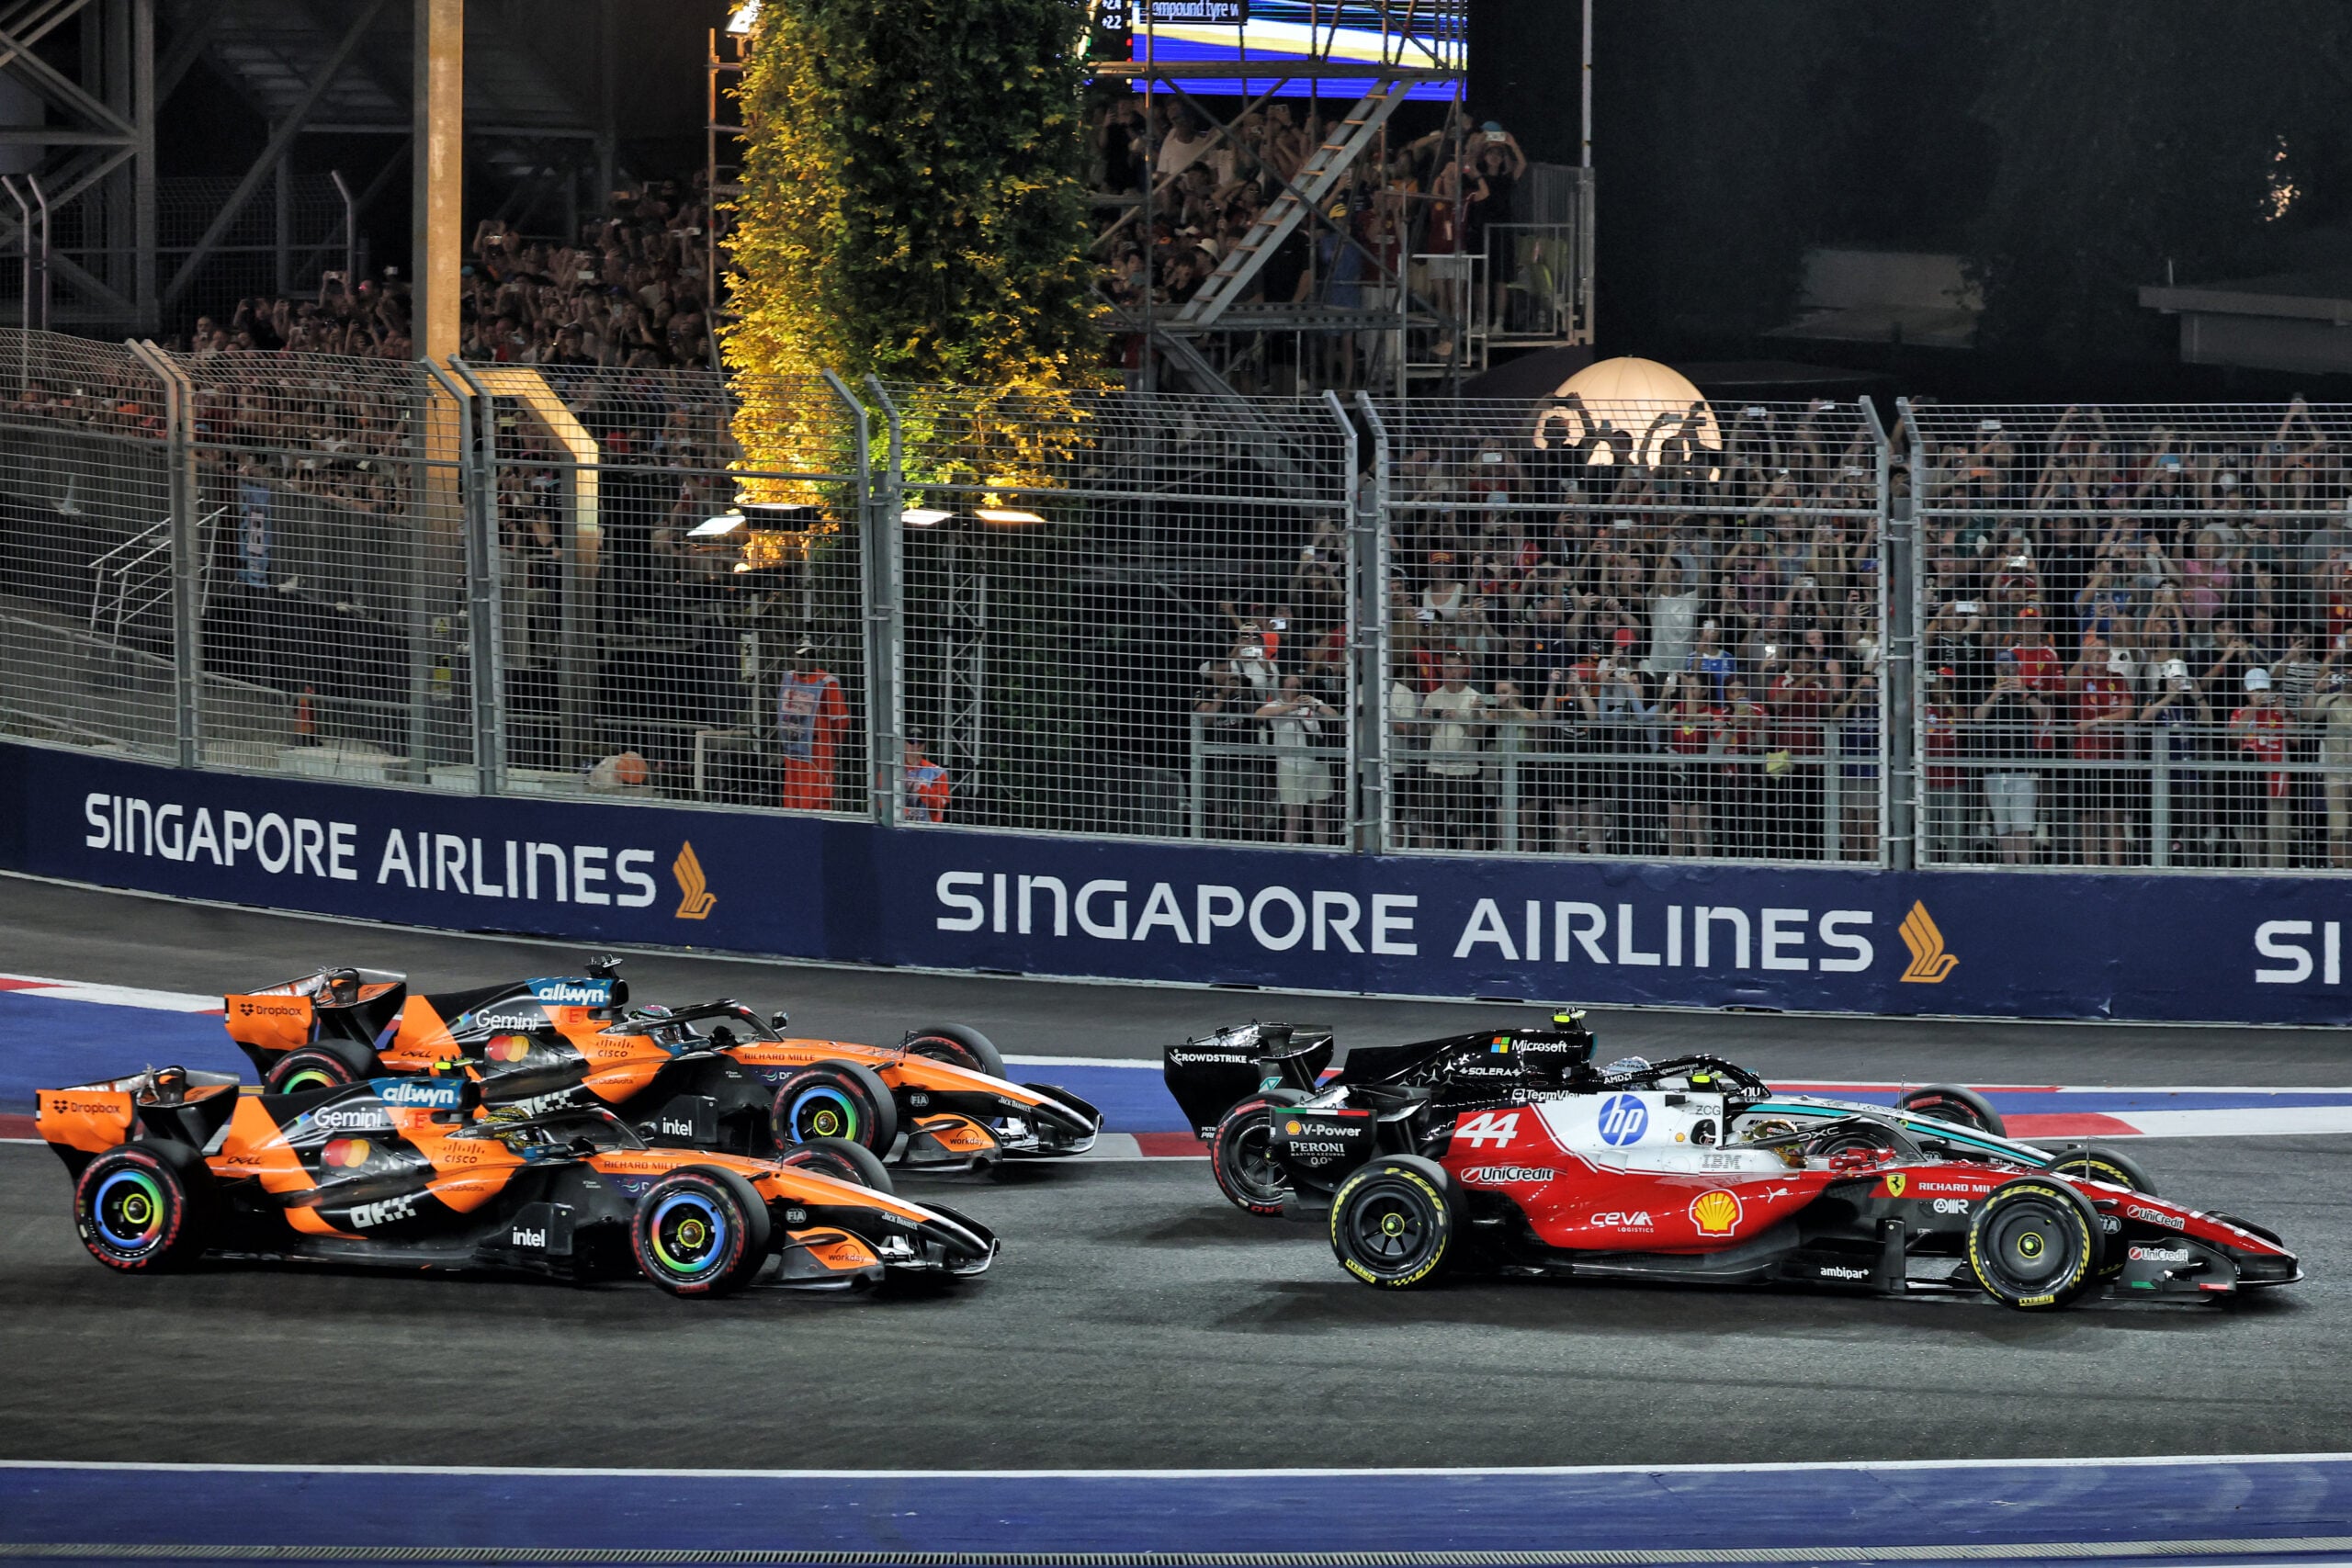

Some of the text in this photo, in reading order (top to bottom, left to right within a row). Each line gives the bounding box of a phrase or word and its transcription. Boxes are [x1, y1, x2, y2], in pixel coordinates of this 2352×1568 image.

[85, 792, 656, 908] SINGAPORE AIRLINES
[936, 871, 1874, 973] SINGAPORE AIRLINES
[538, 983, 605, 1006] allwyn
[255, 1005, 302, 1017] Dropbox
[476, 1010, 539, 1031] Gemini
[1511, 1039, 1567, 1053] Microsoft
[744, 1053, 816, 1062] RICHARD MILLE
[1175, 1053, 1248, 1064] CROWDSTRIKE
[1468, 1066, 1512, 1077] SOLERA
[1603, 1074, 1624, 1084] AMD
[381, 1084, 455, 1108] allwyn
[71, 1102, 121, 1114] Dropbox
[313, 1107, 383, 1129] Gemini
[1601, 1094, 1645, 1145] hp
[662, 1117, 693, 1136] intel
[1302, 1123, 1362, 1137] V-Power
[1453, 1113, 1521, 1148] 44
[950, 1137, 985, 1146] workday
[1797, 1127, 1840, 1142] DXC
[1289, 1141, 1345, 1153] PERONI
[604, 1161, 649, 1169] RICHARD
[1702, 1154, 1742, 1170] IBM
[1481, 1167, 1554, 1182] UniCredit
[1918, 1182, 1969, 1192] RICHARD
[2139, 1208, 2185, 1230] UniCredit
[513, 1226, 546, 1247] intel
[828, 1253, 865, 1264] workday
[2142, 1248, 2188, 1261] UniCredit
[1820, 1266, 1865, 1280] ambipar
